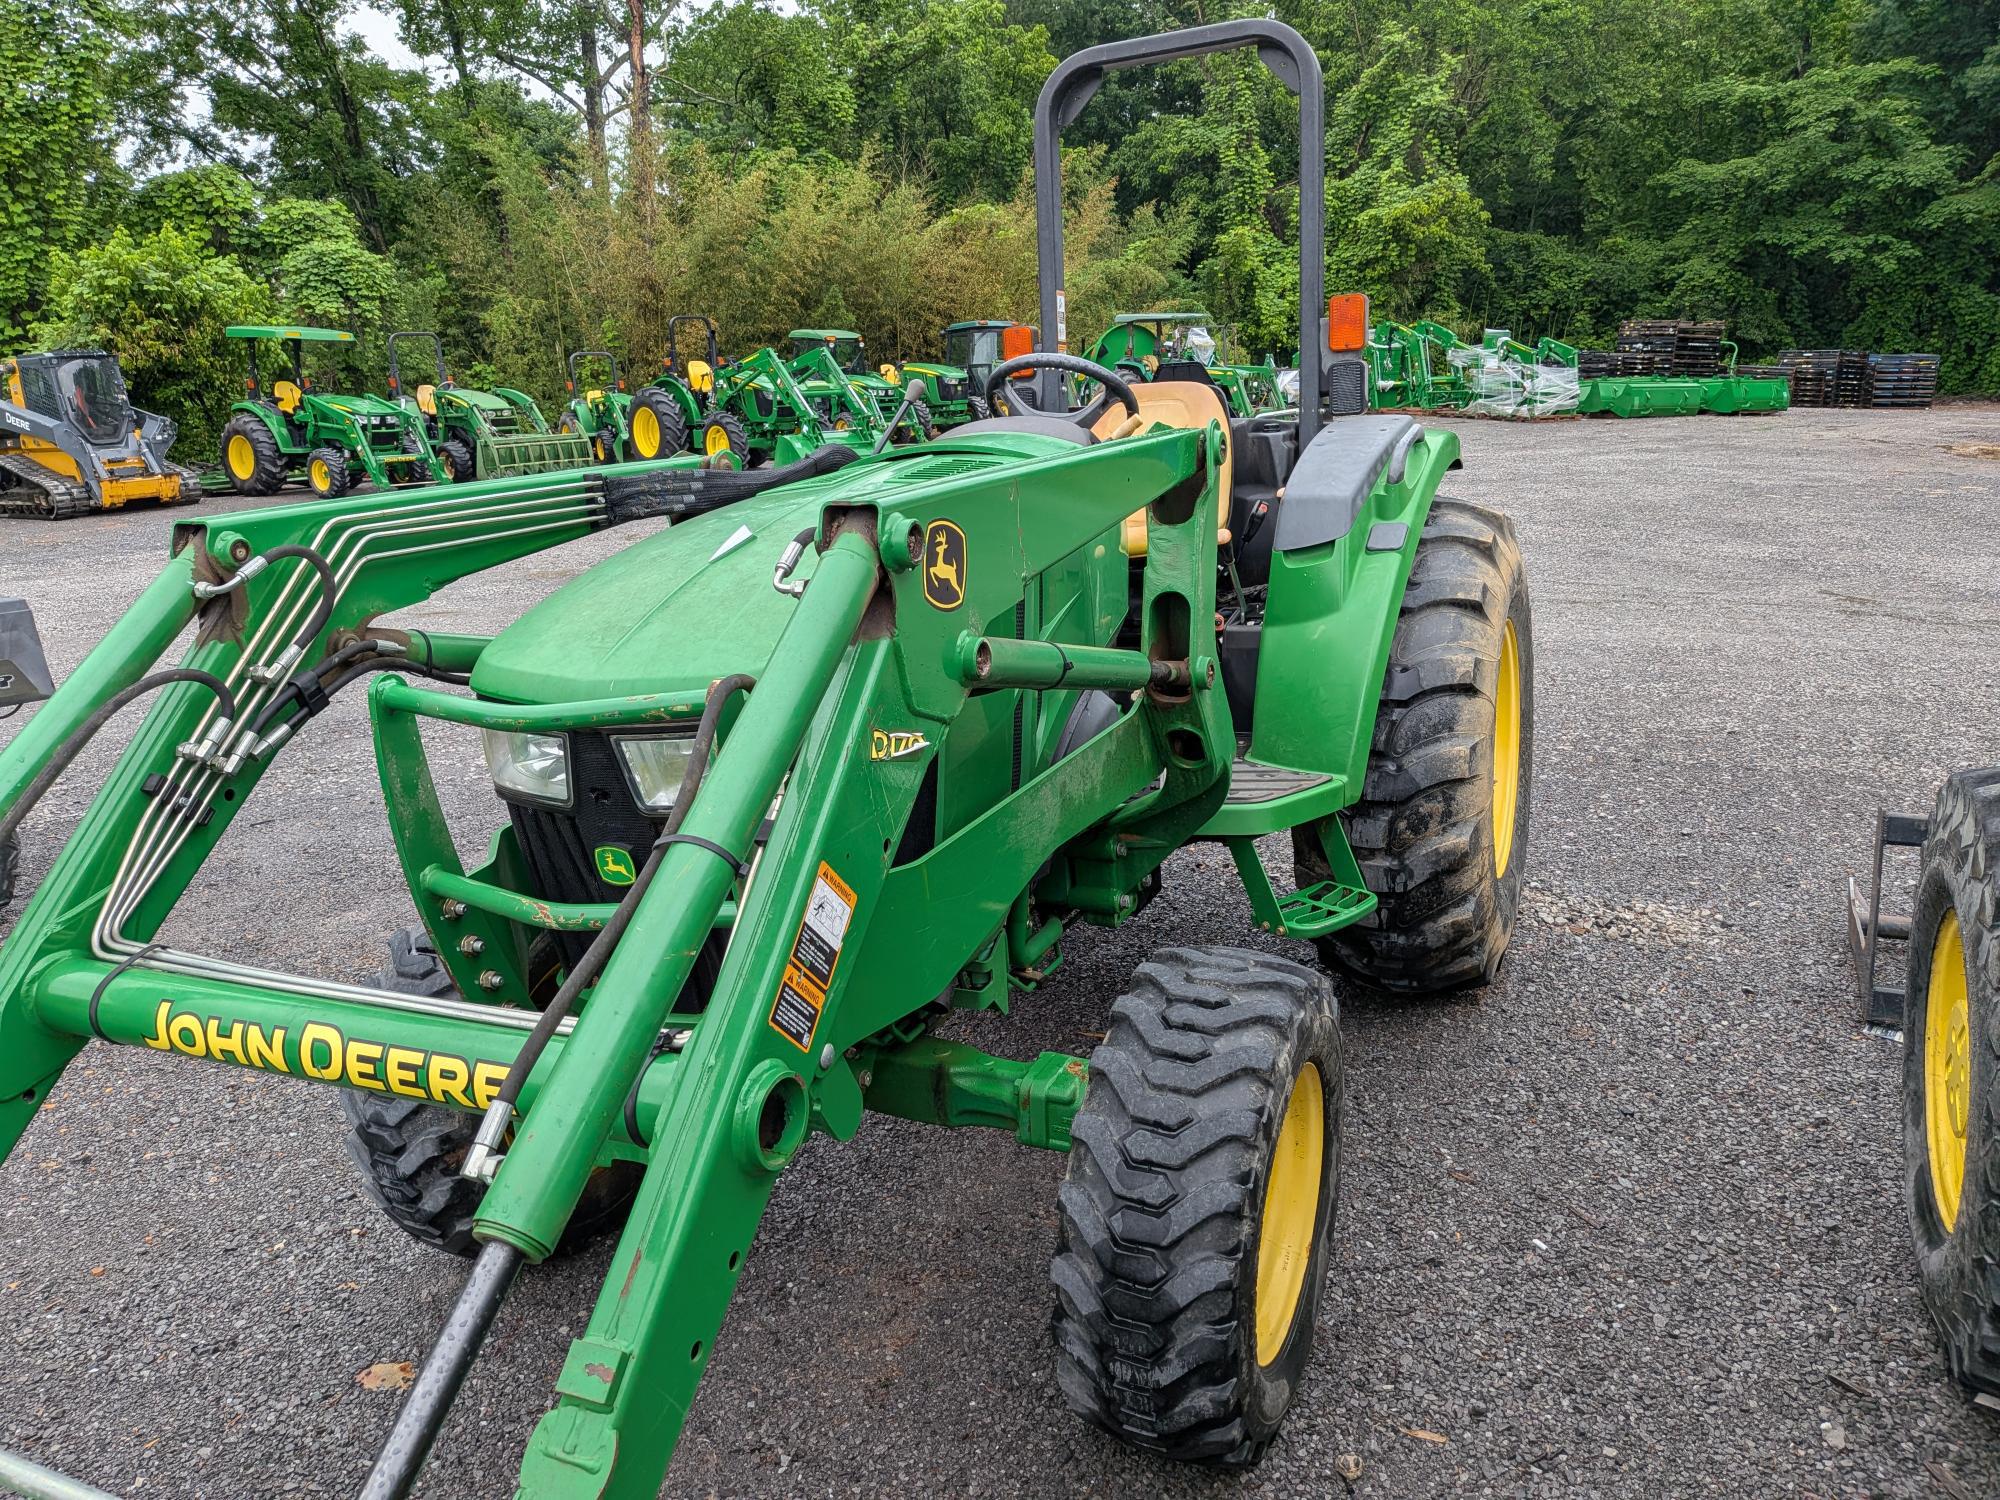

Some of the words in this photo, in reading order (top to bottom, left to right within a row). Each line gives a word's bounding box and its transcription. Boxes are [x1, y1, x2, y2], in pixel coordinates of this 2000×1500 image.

[6, 411, 31, 431] DEERE
[828, 874, 853, 903] WARNING
[142, 999, 294, 1074] JOHN
[300, 1020, 518, 1117] DEERE
